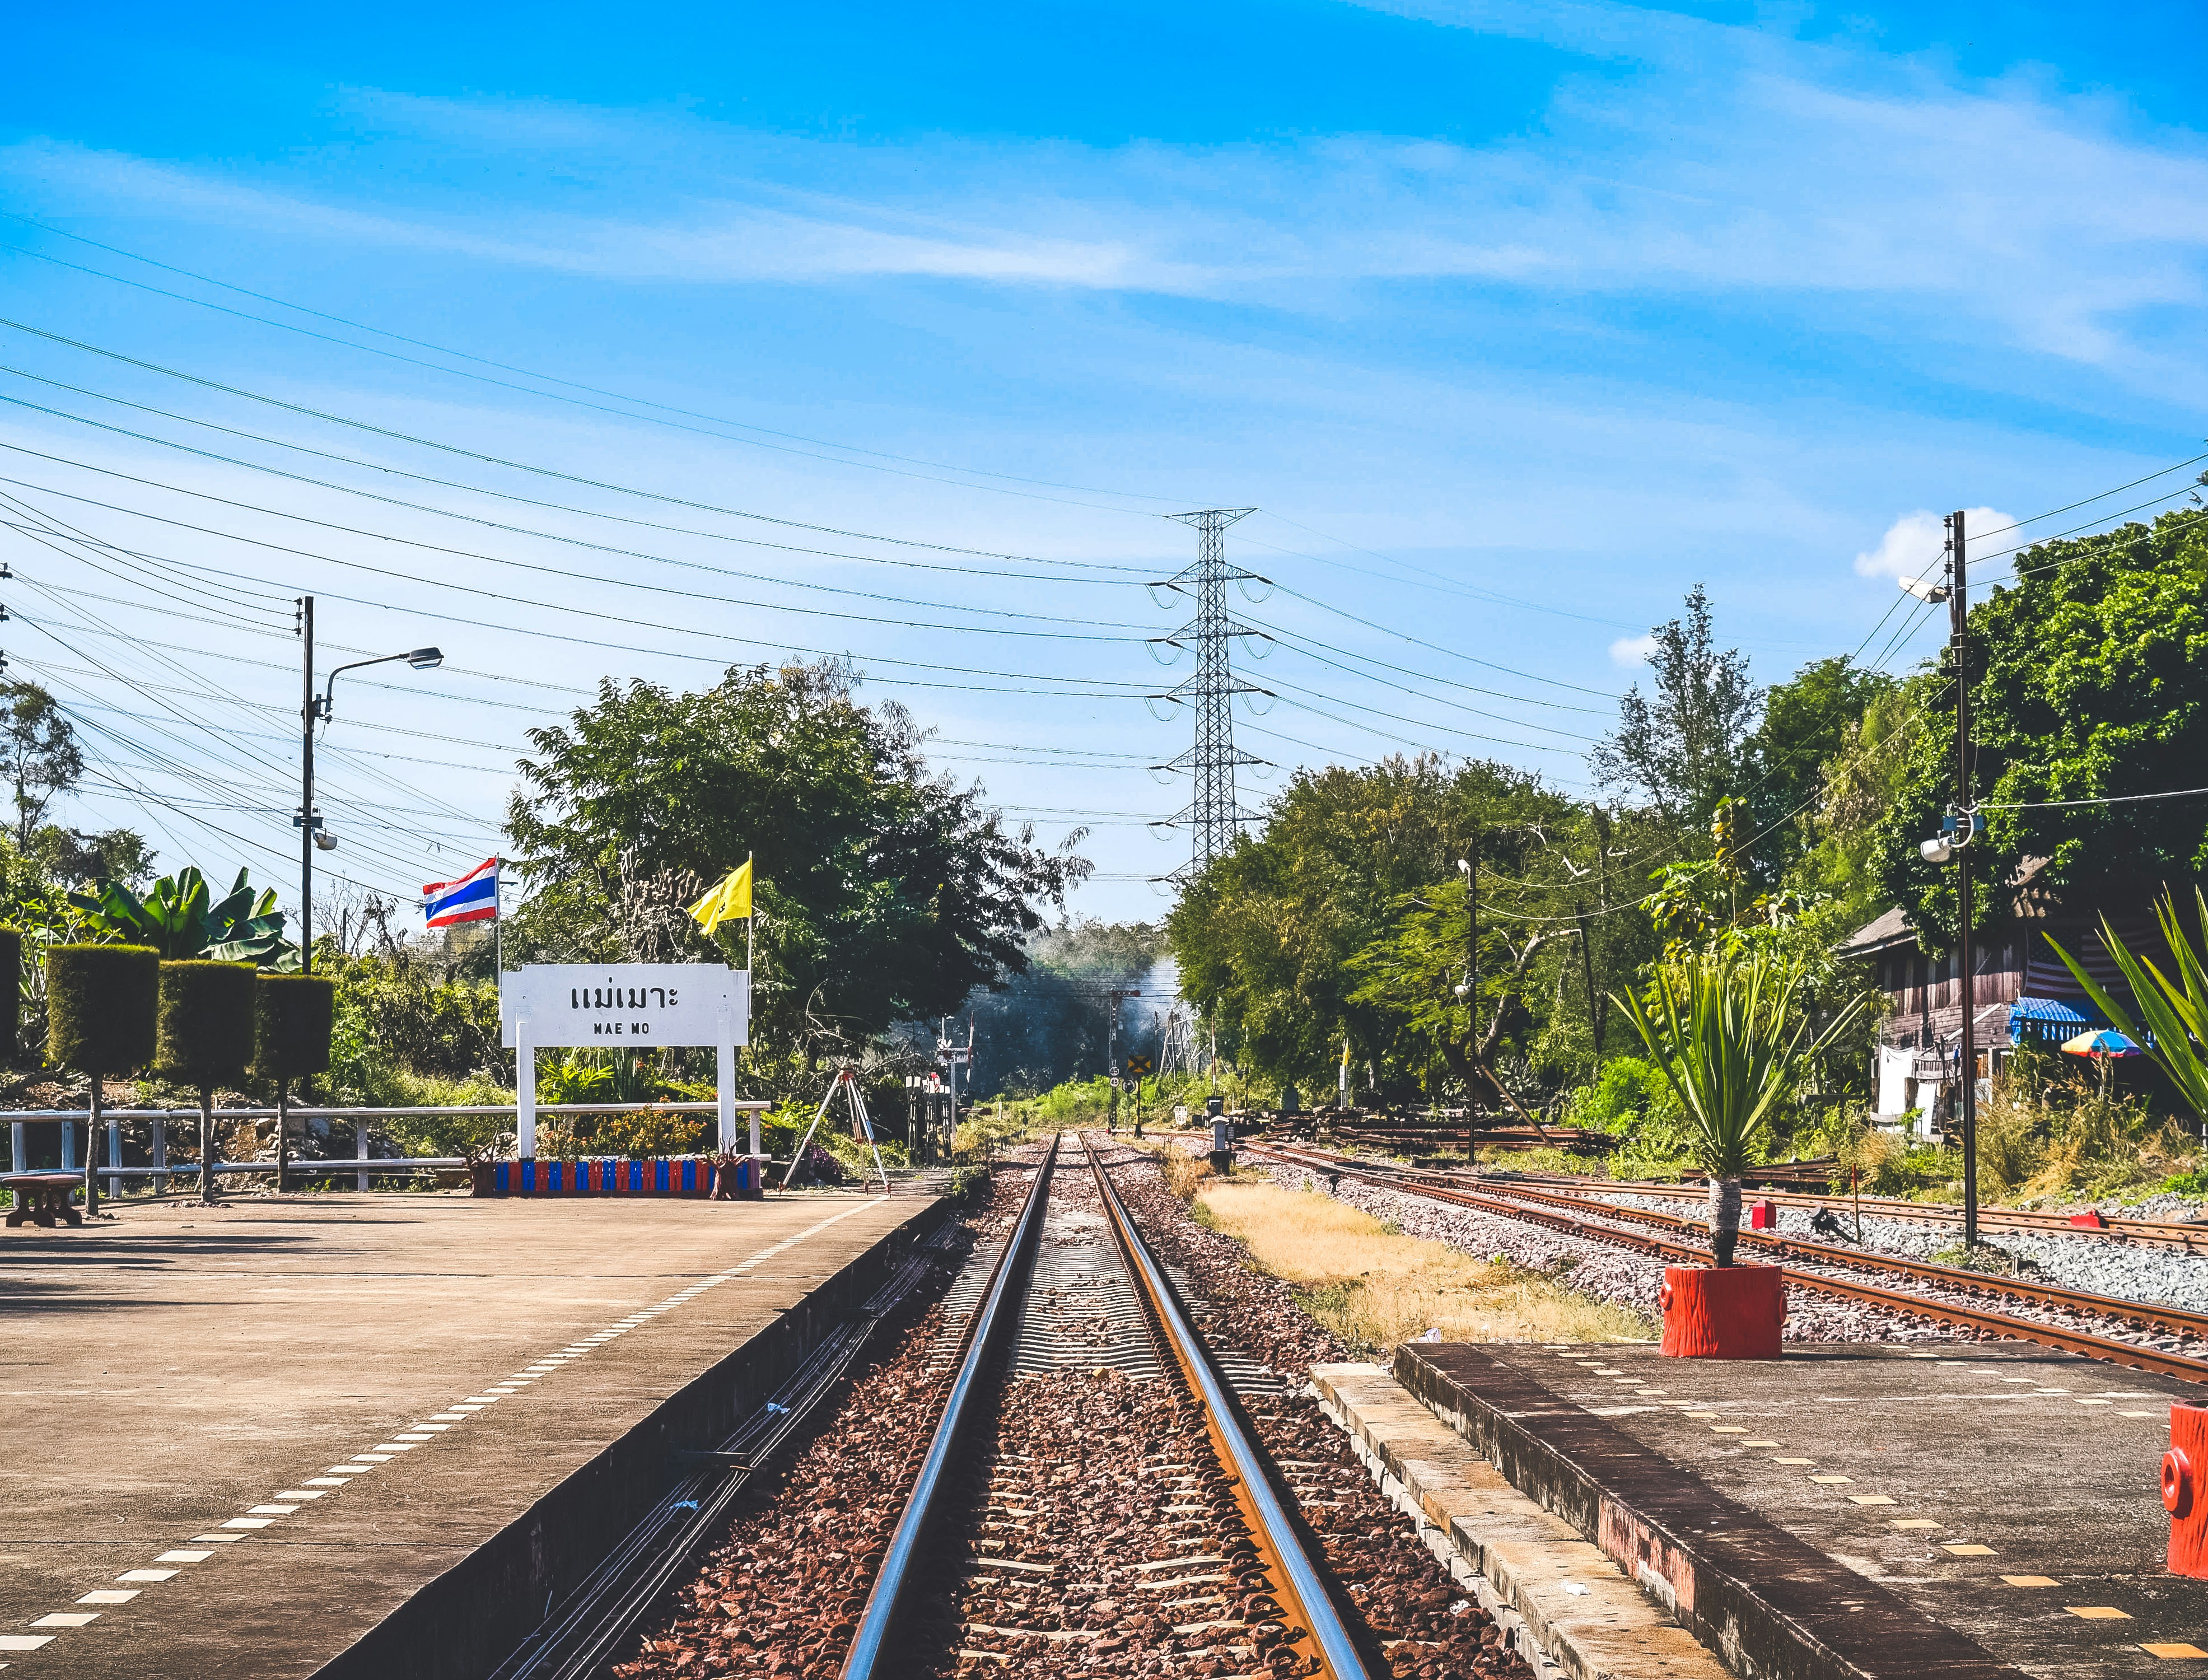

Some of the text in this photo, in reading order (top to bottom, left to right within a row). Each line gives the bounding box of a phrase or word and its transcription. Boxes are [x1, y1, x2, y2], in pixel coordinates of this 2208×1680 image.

[571, 977, 678, 1009] แม่เมาะ
[594, 1023, 649, 1034] MAE MO
